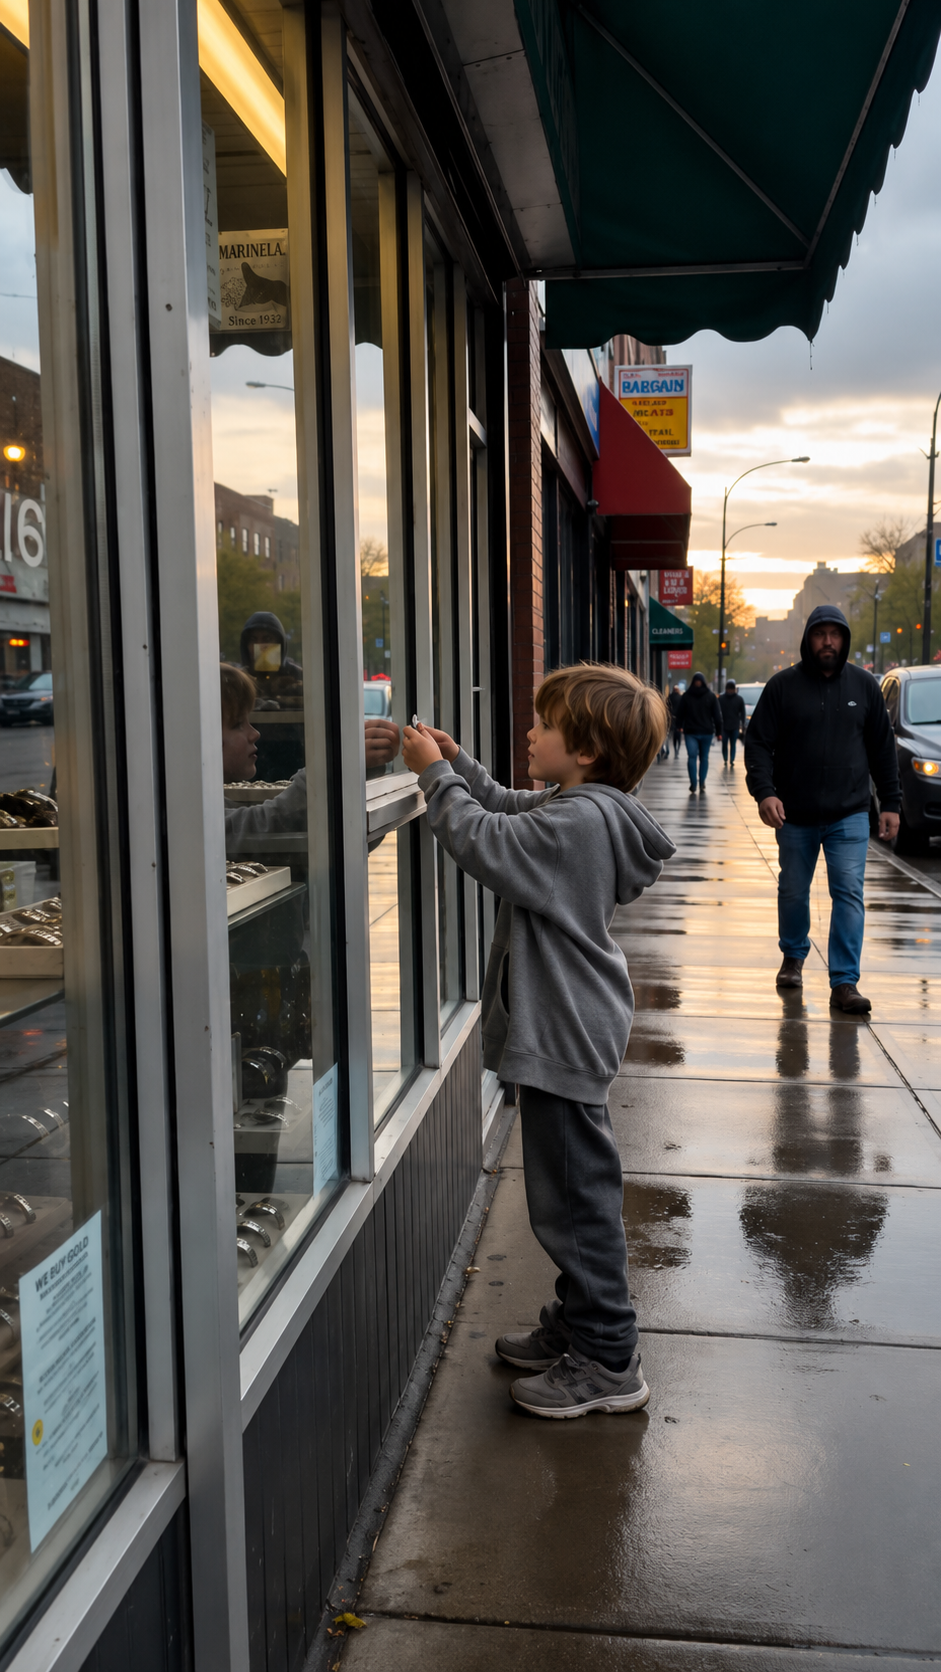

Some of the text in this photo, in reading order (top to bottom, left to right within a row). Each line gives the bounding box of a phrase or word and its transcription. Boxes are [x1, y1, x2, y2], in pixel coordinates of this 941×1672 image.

[228, 313, 282, 326] Since 1932
[651, 627, 684, 635] CLEANERS
[35, 1236, 89, 1293] WE BUY GOLD
